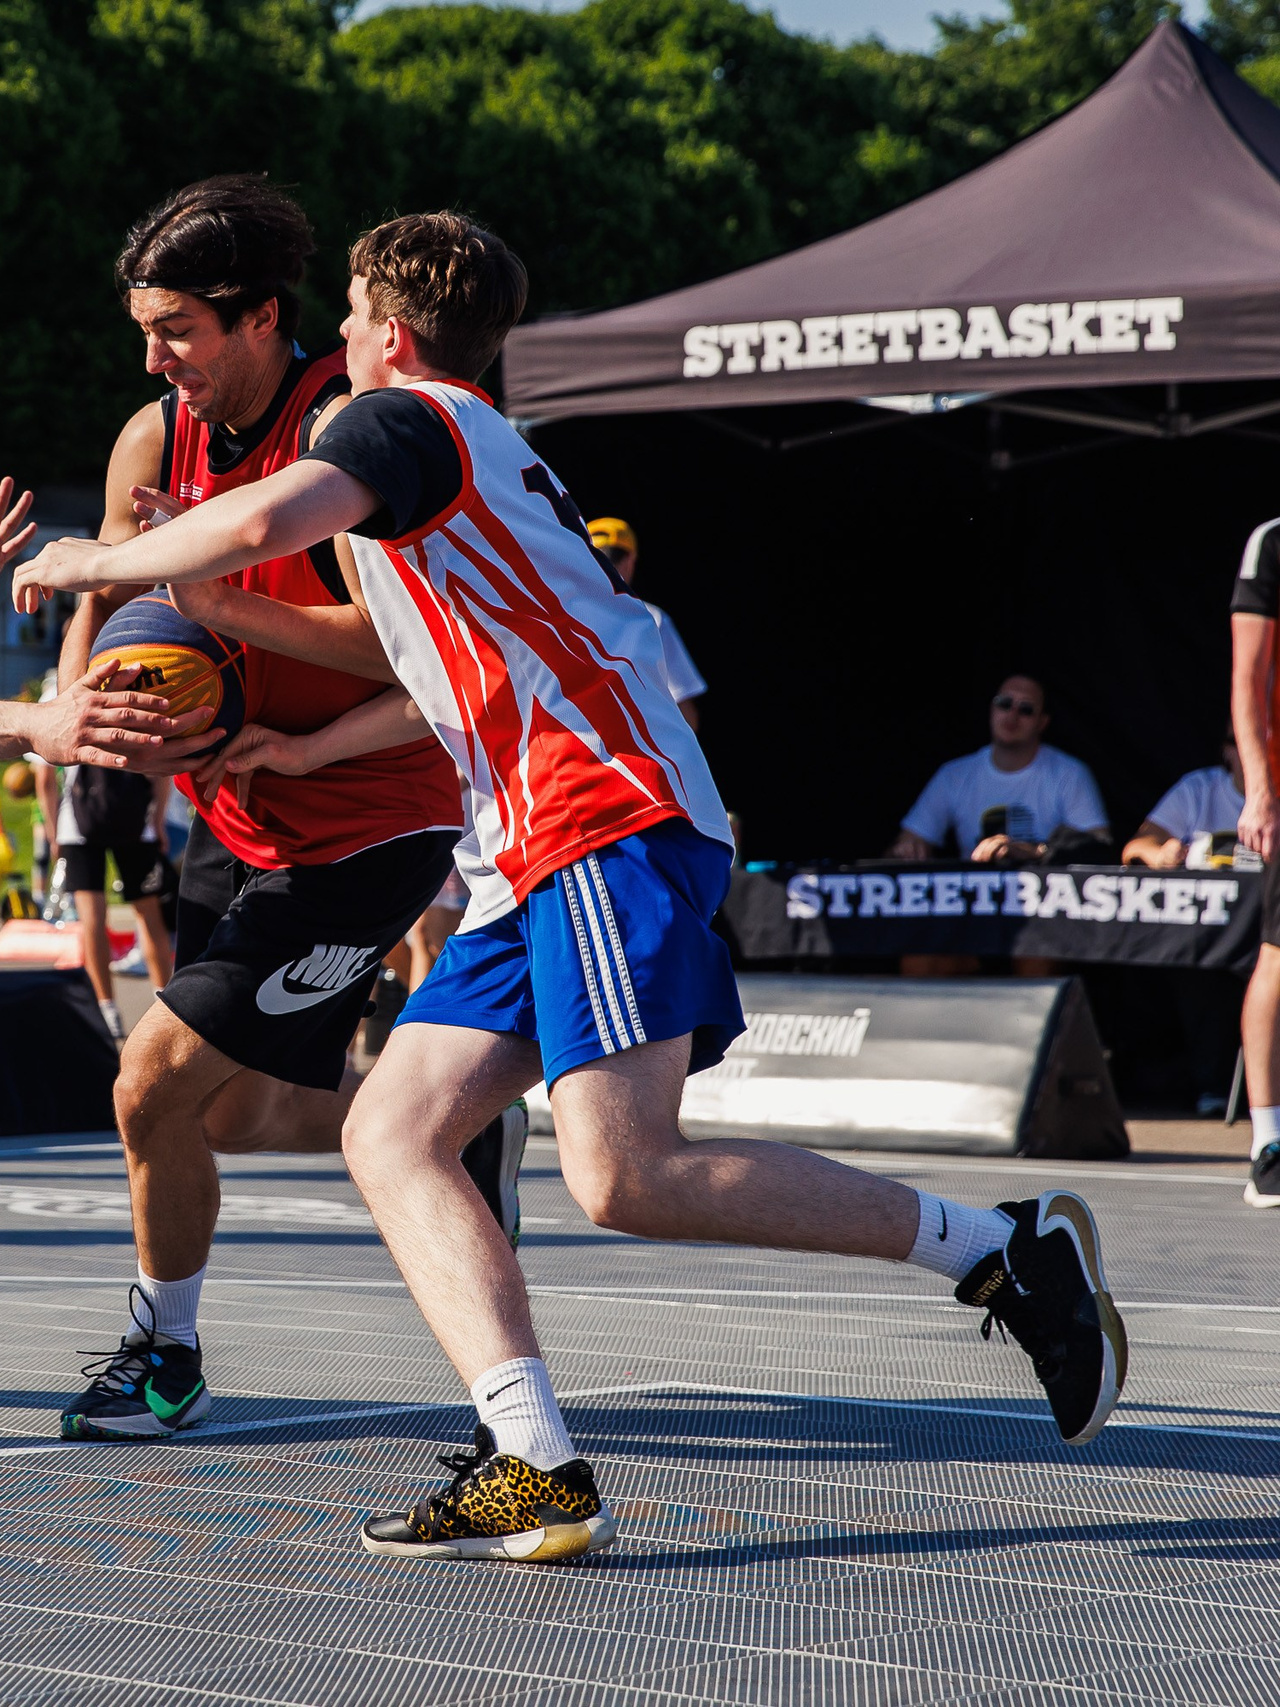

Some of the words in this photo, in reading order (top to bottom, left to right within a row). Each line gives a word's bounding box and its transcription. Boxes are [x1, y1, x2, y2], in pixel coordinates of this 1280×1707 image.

[683, 296, 1185, 378] STREETBASKET
[786, 872, 1240, 925] STREETBASKET
[287, 944, 378, 989] NIKE
[734, 1008, 871, 1057] КОВСКИЙ
